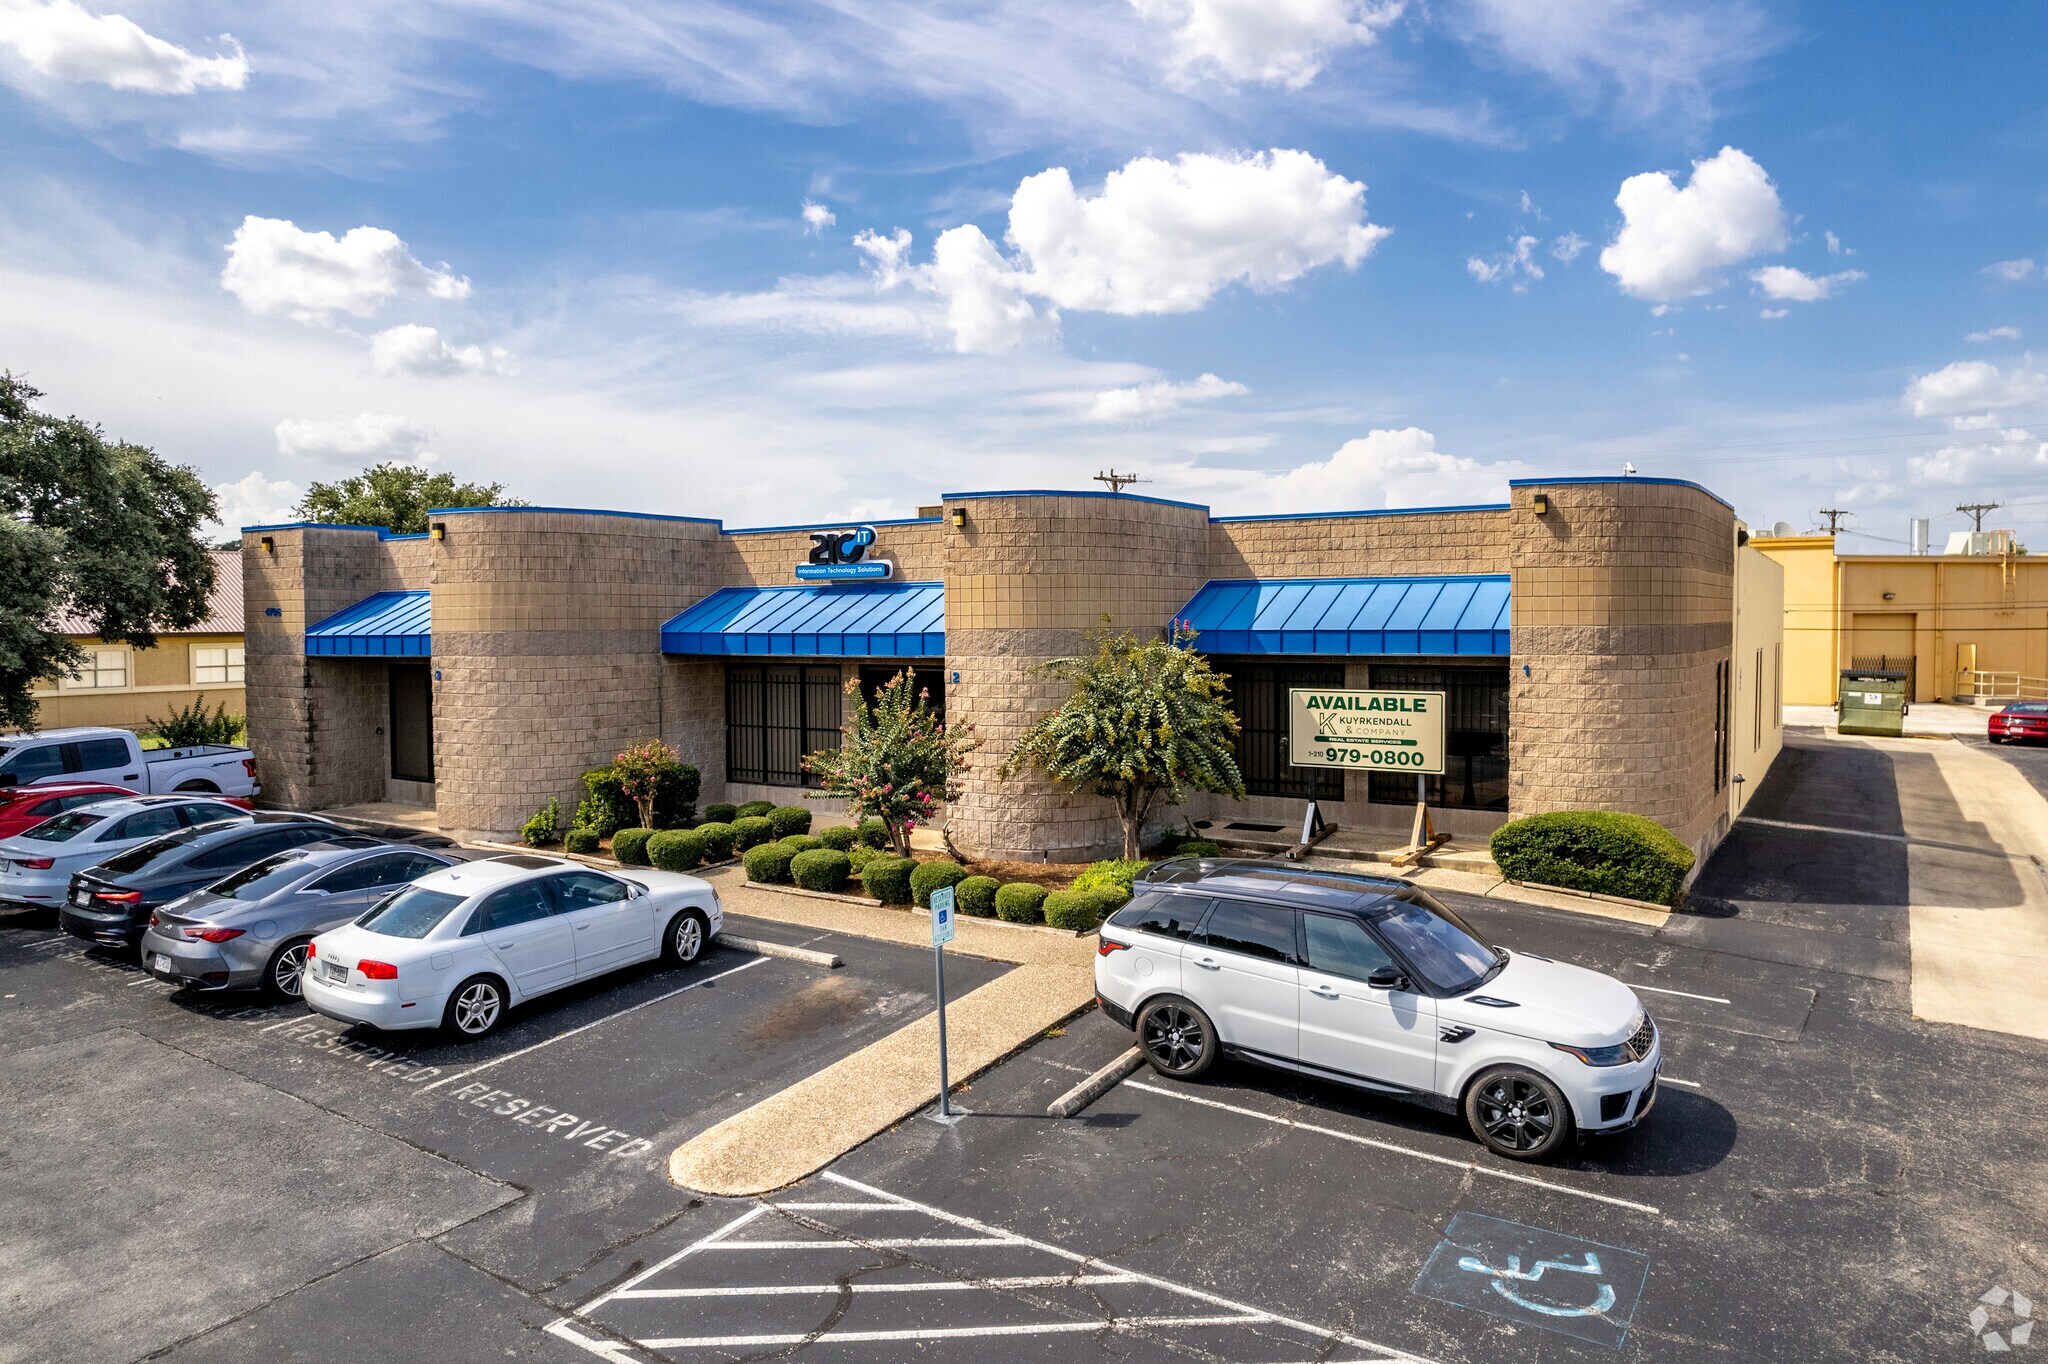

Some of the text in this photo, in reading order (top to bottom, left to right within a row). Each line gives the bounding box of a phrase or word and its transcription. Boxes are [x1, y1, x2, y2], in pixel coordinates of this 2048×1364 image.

[857, 530, 869, 543] IT
[797, 565, 882, 575] Information Technology Solutions
[952, 671, 960, 683] 2
[1306, 695, 1427, 713] AVAILABLE
[1319, 712, 1338, 735] K
[1339, 716, 1412, 727] KUYRKENDALL
[1345, 726, 1406, 736] & COMPANY
[210, 759, 239, 768] SPORT
[1308, 747, 1425, 767] 1-210 979-0800
[276, 1022, 442, 1083] RESERVED
[449, 1081, 654, 1158] RESERVED
